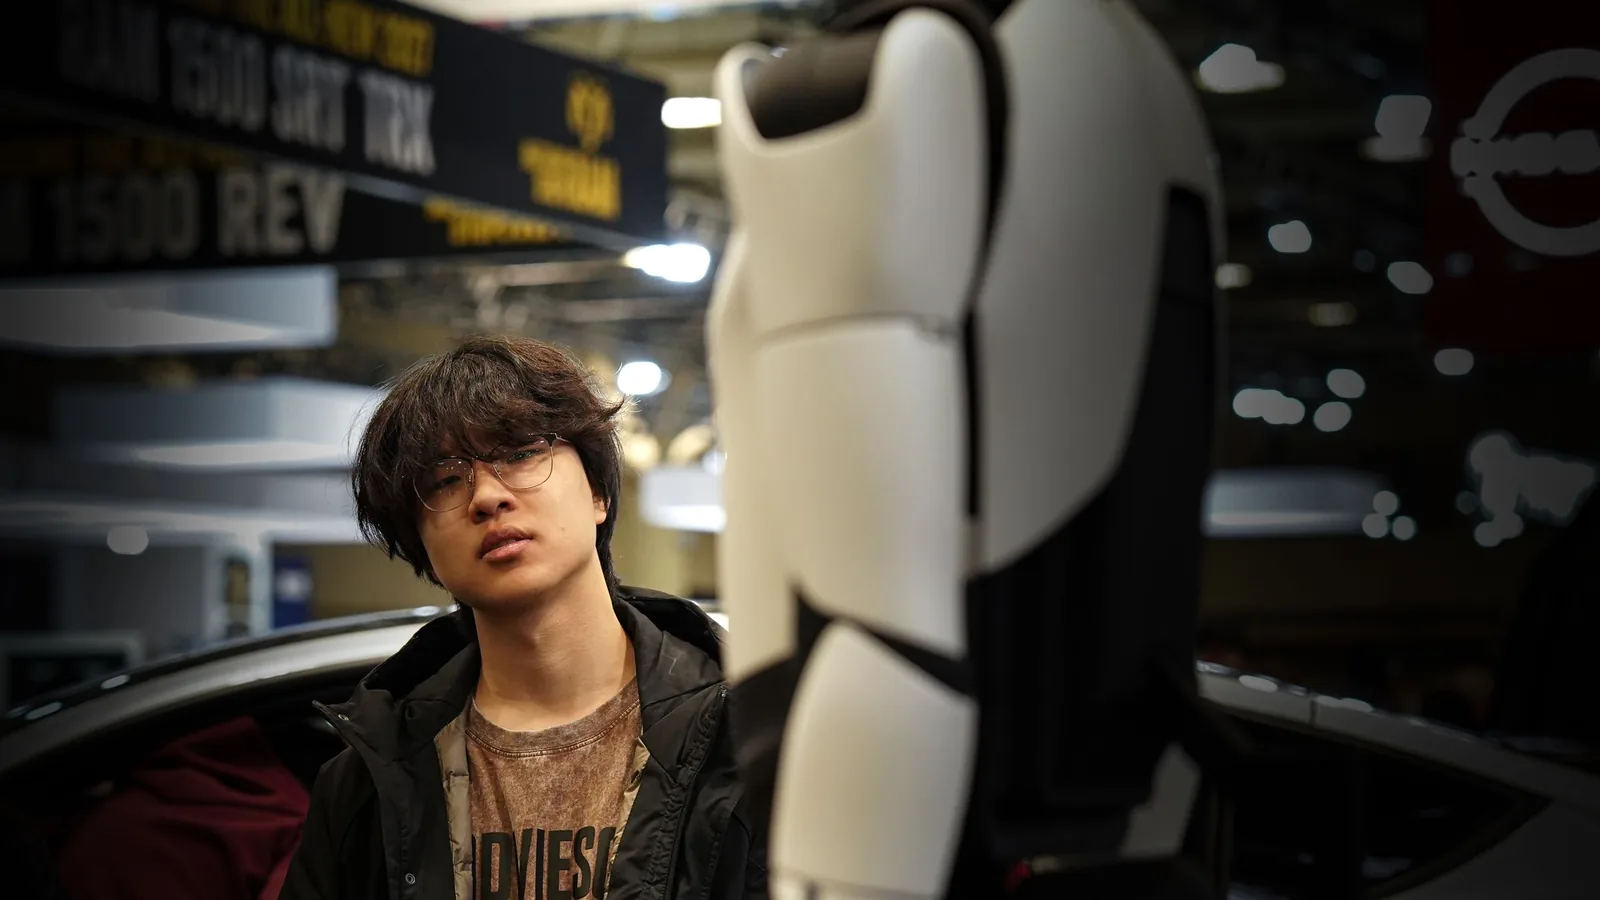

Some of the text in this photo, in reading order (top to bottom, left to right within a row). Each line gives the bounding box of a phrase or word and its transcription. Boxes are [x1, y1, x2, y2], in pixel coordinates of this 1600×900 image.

[167, 17, 266, 134] 1500
[50, 168, 198, 260] 1500
[219, 160, 346, 257] REV
[471, 826, 616, 900] DVIES
